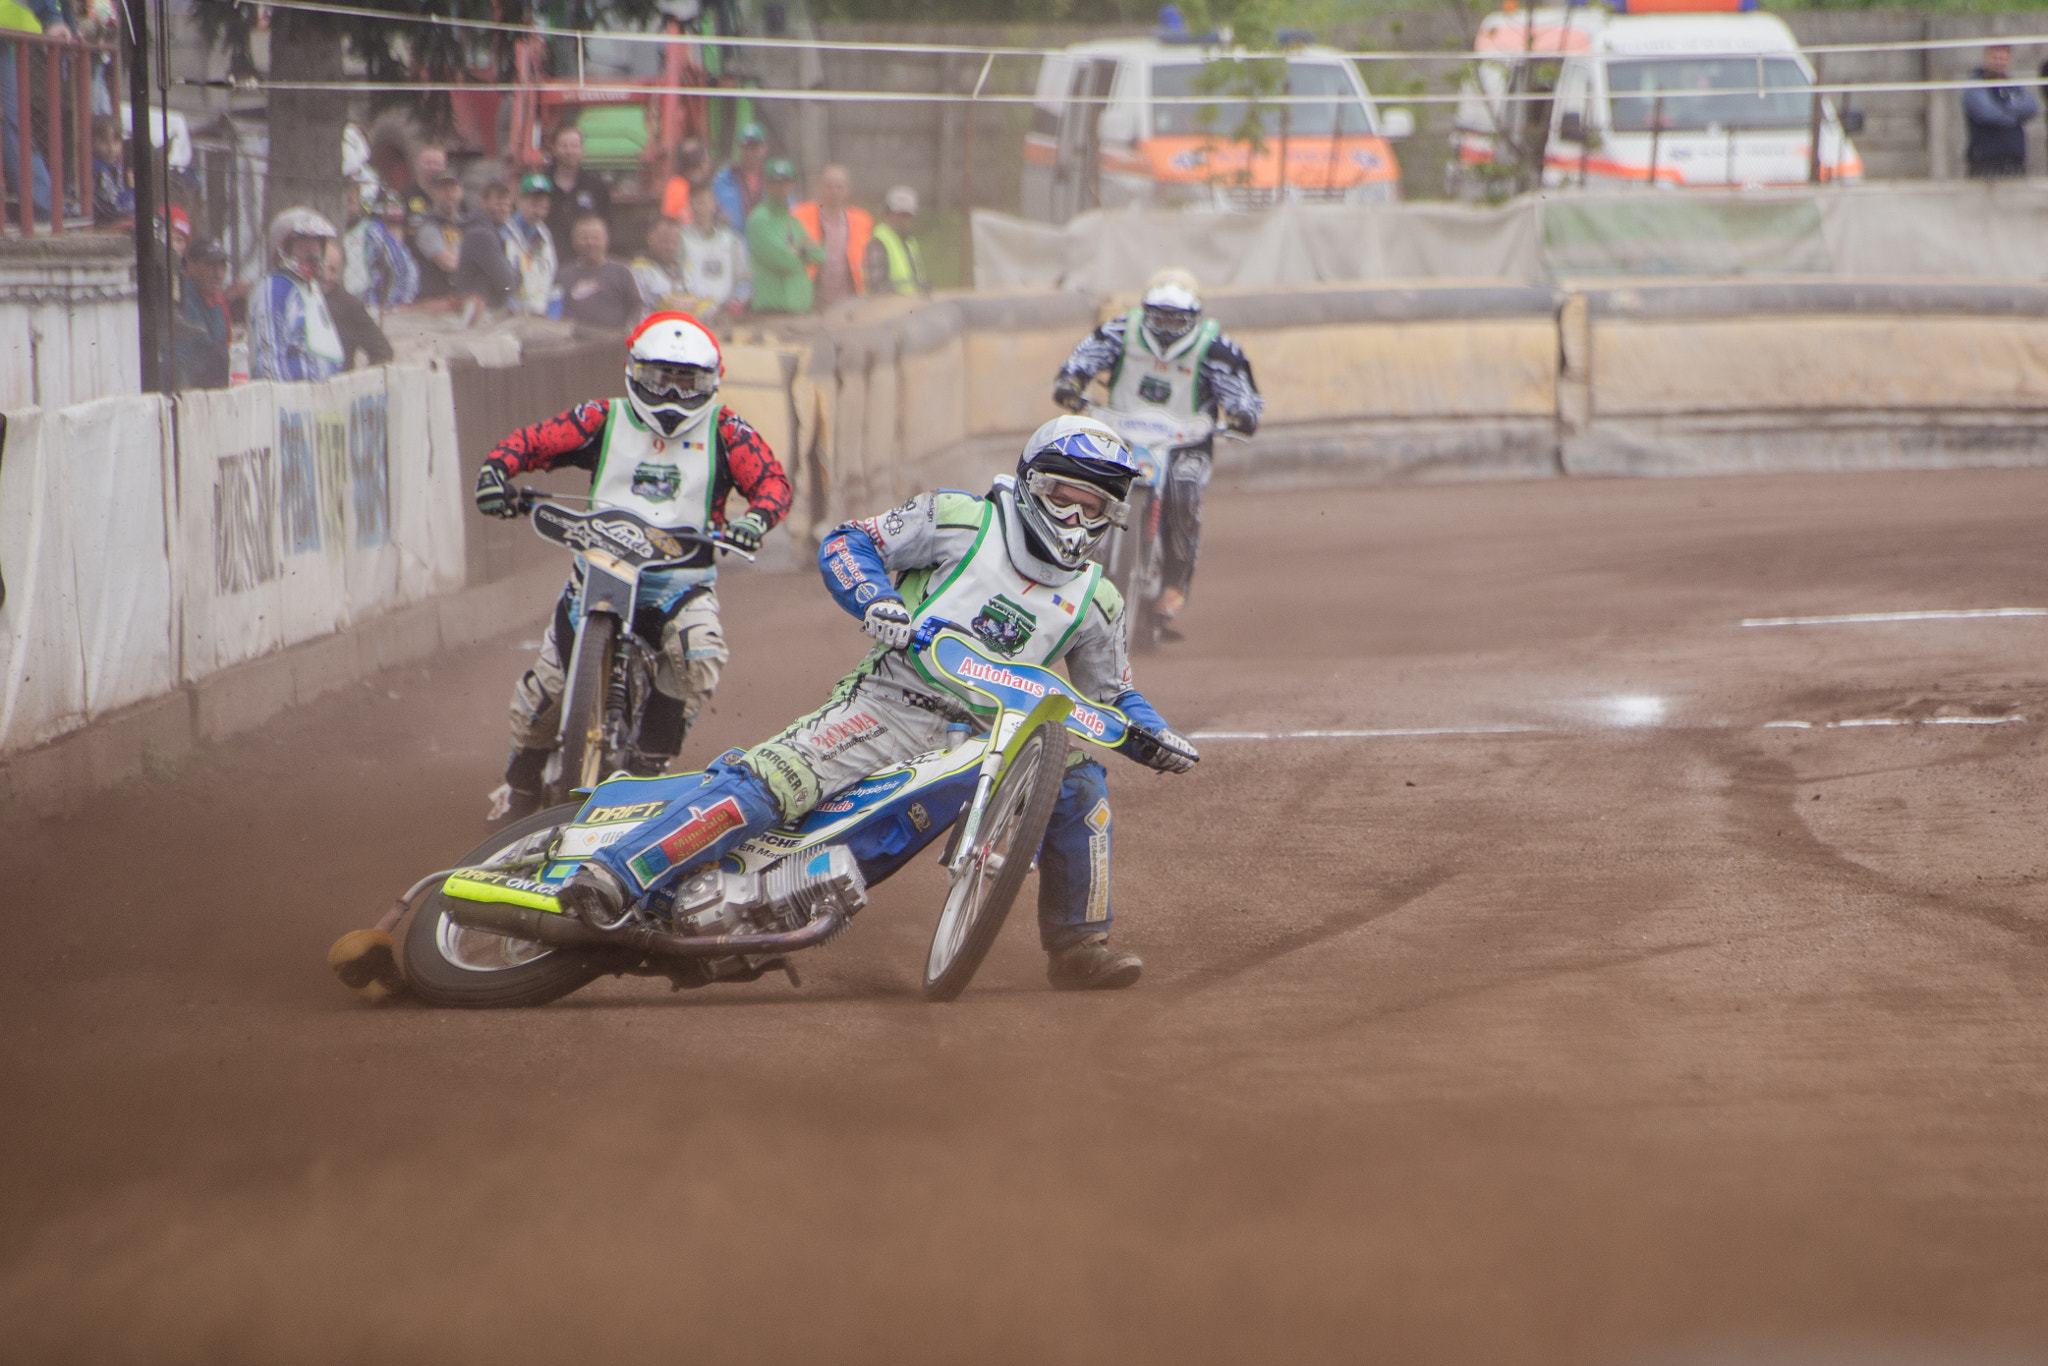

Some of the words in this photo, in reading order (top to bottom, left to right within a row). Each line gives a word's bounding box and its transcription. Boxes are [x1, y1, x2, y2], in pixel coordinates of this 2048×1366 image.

[653, 438, 666, 456] 9
[593, 519, 654, 558] Linde
[957, 656, 1045, 698] Autohaus
[585, 801, 664, 823] DRIFT
[456, 869, 506, 884] DRIFT
[506, 878, 533, 890] ON
